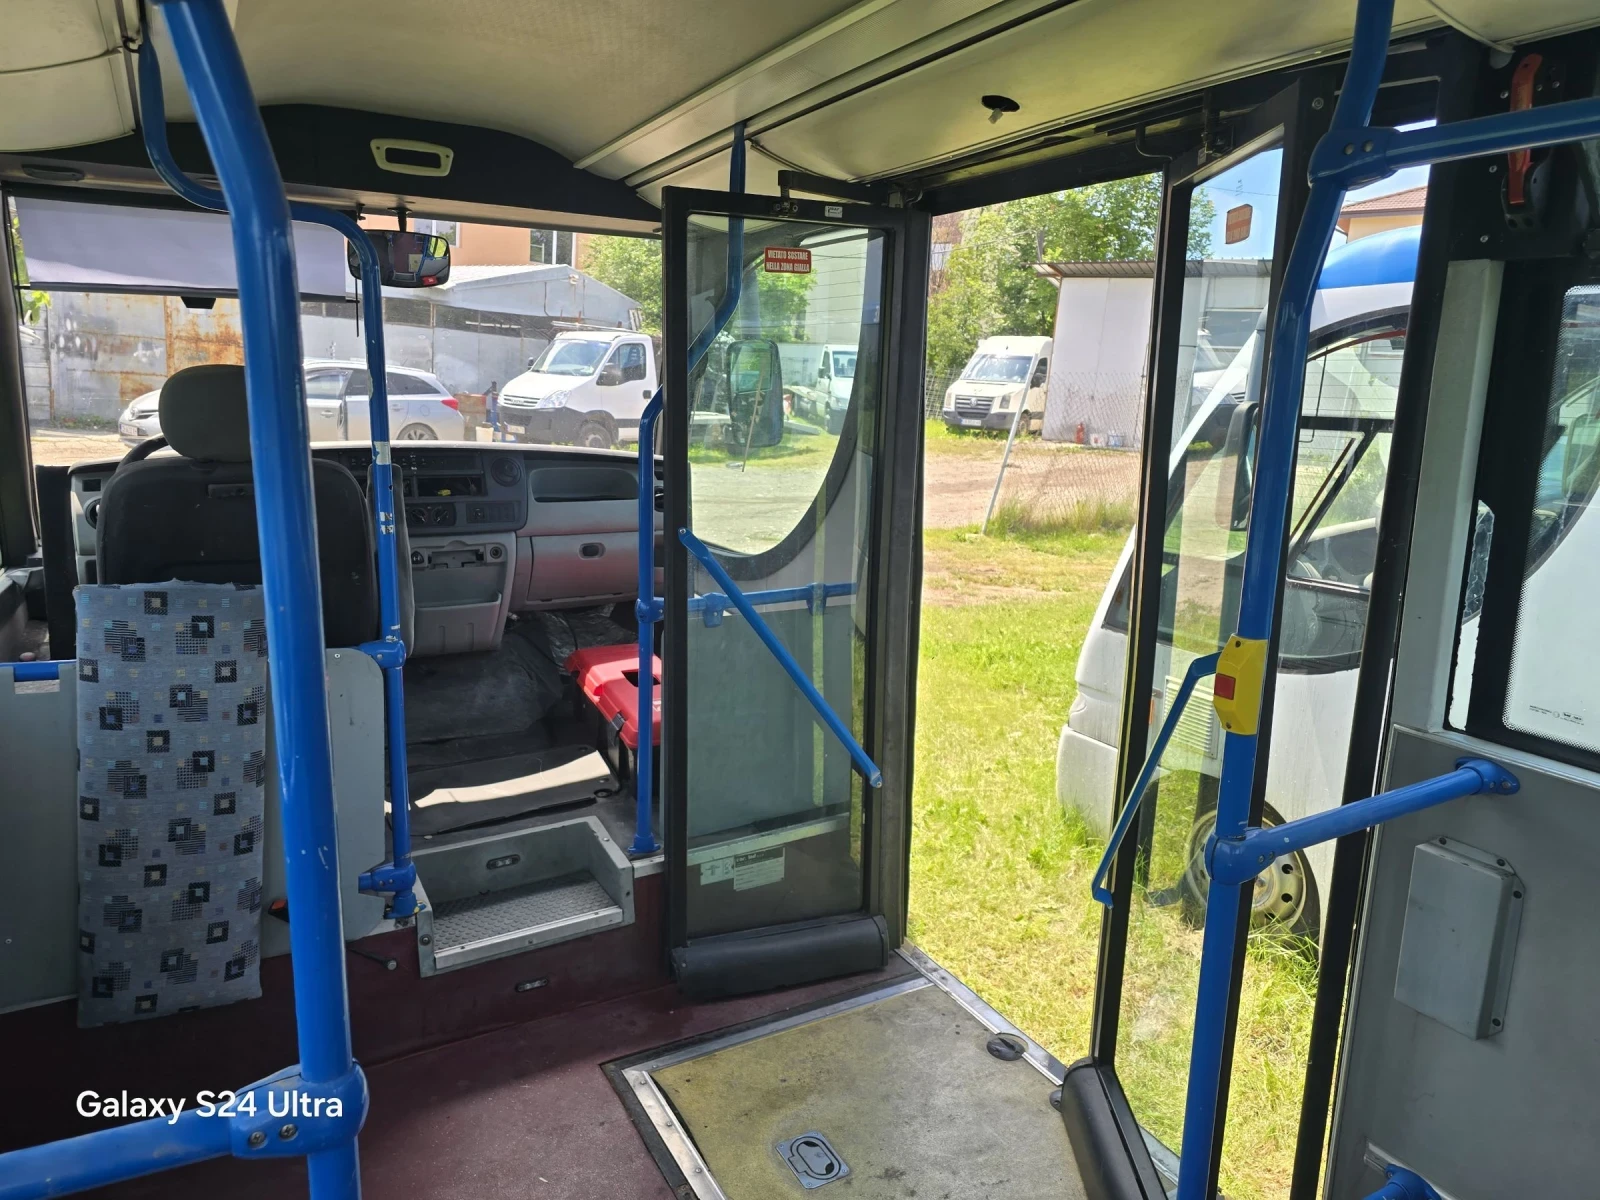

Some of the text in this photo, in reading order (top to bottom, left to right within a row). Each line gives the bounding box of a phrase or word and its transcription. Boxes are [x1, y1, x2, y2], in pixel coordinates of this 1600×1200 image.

[767, 249, 808, 260] VIETATO SOSTARE
[766, 261, 780, 271] NELLA
[781, 262, 793, 271] ZONA
